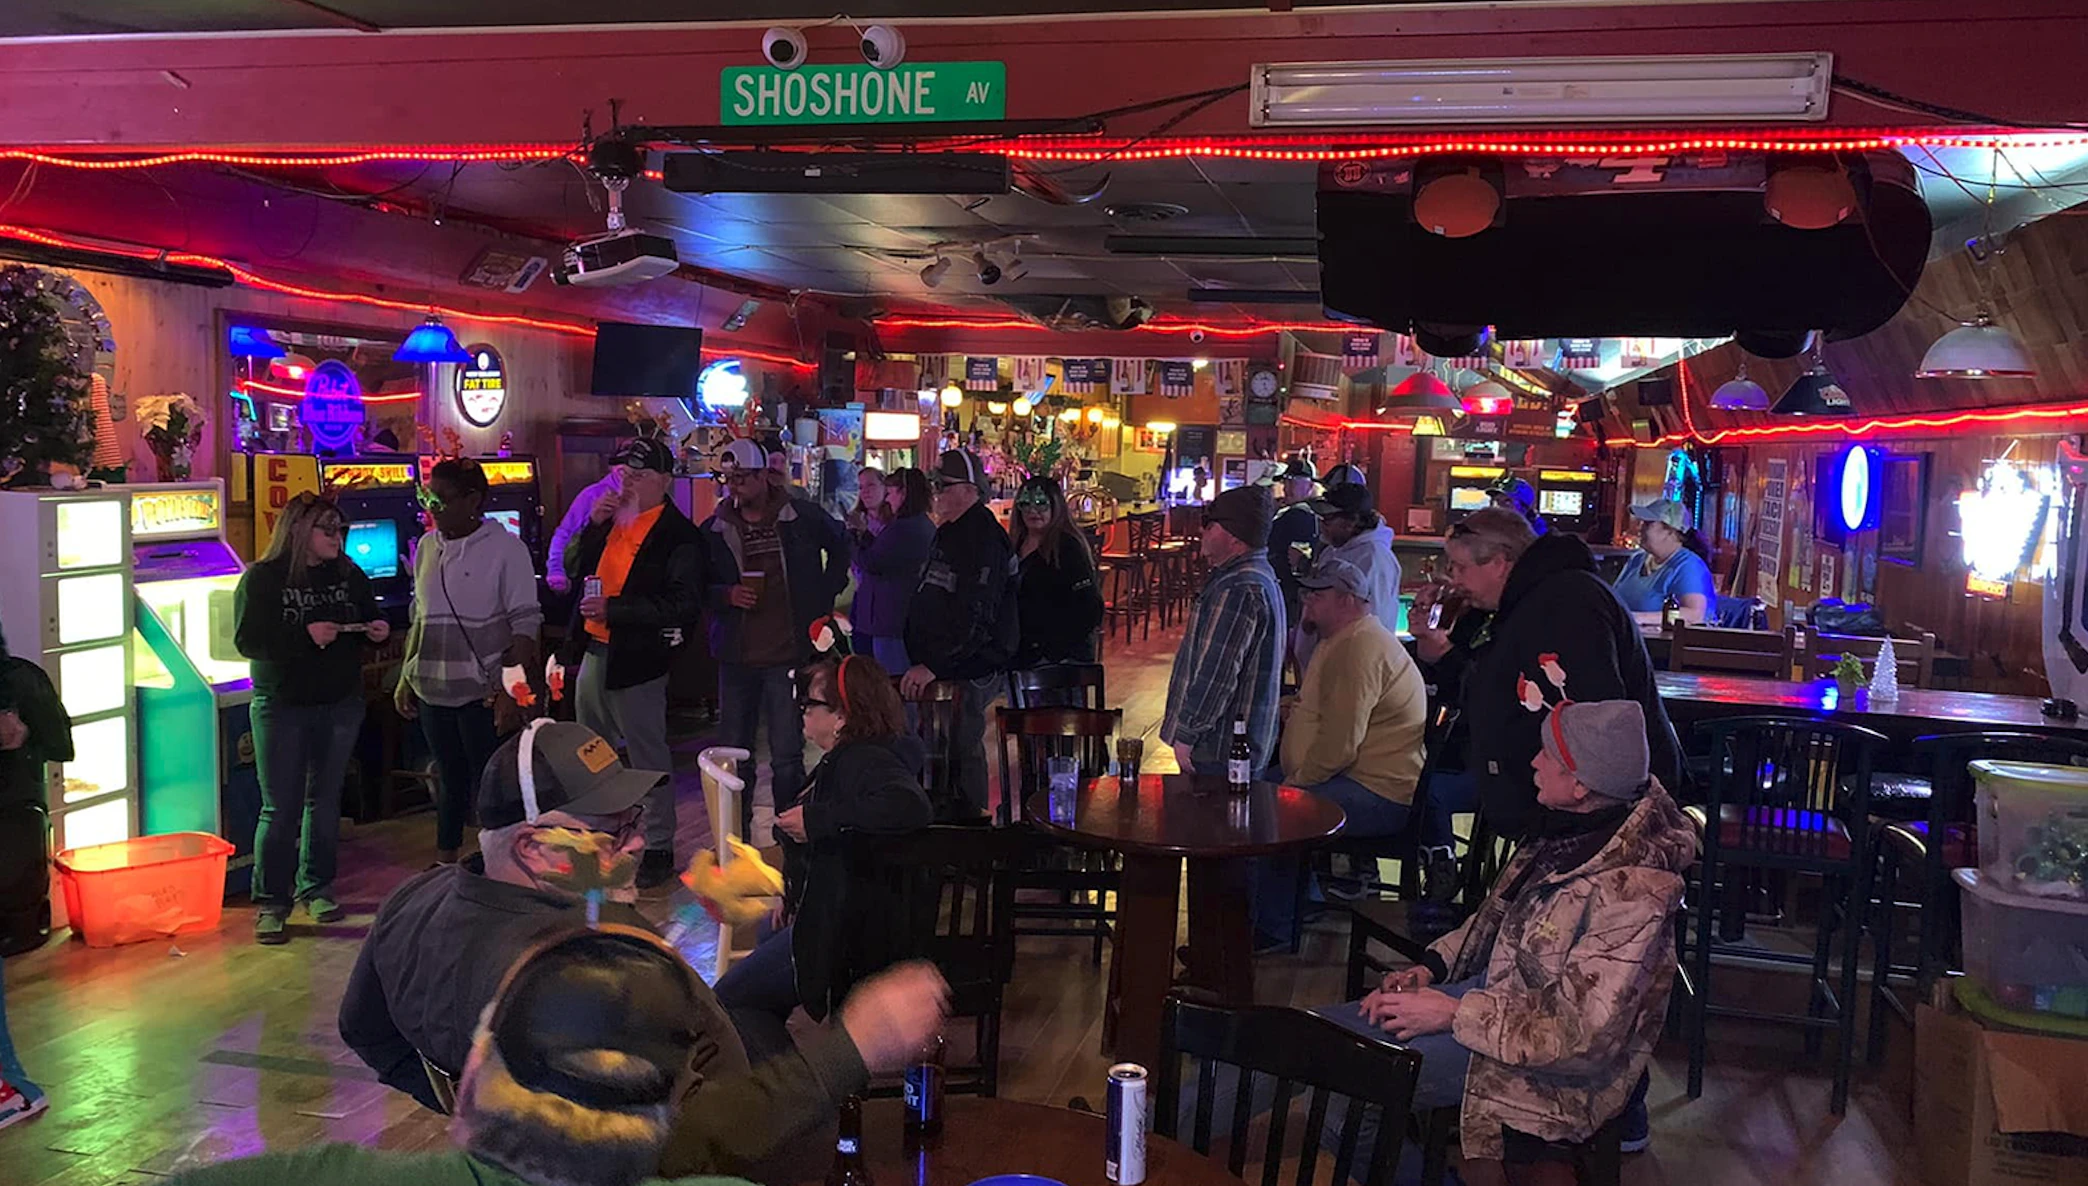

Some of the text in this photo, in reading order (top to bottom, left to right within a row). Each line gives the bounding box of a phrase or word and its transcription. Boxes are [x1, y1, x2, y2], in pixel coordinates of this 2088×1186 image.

[733, 71, 989, 117] SHOSHONE AV
[464, 378, 501, 389] FAT TIRE
